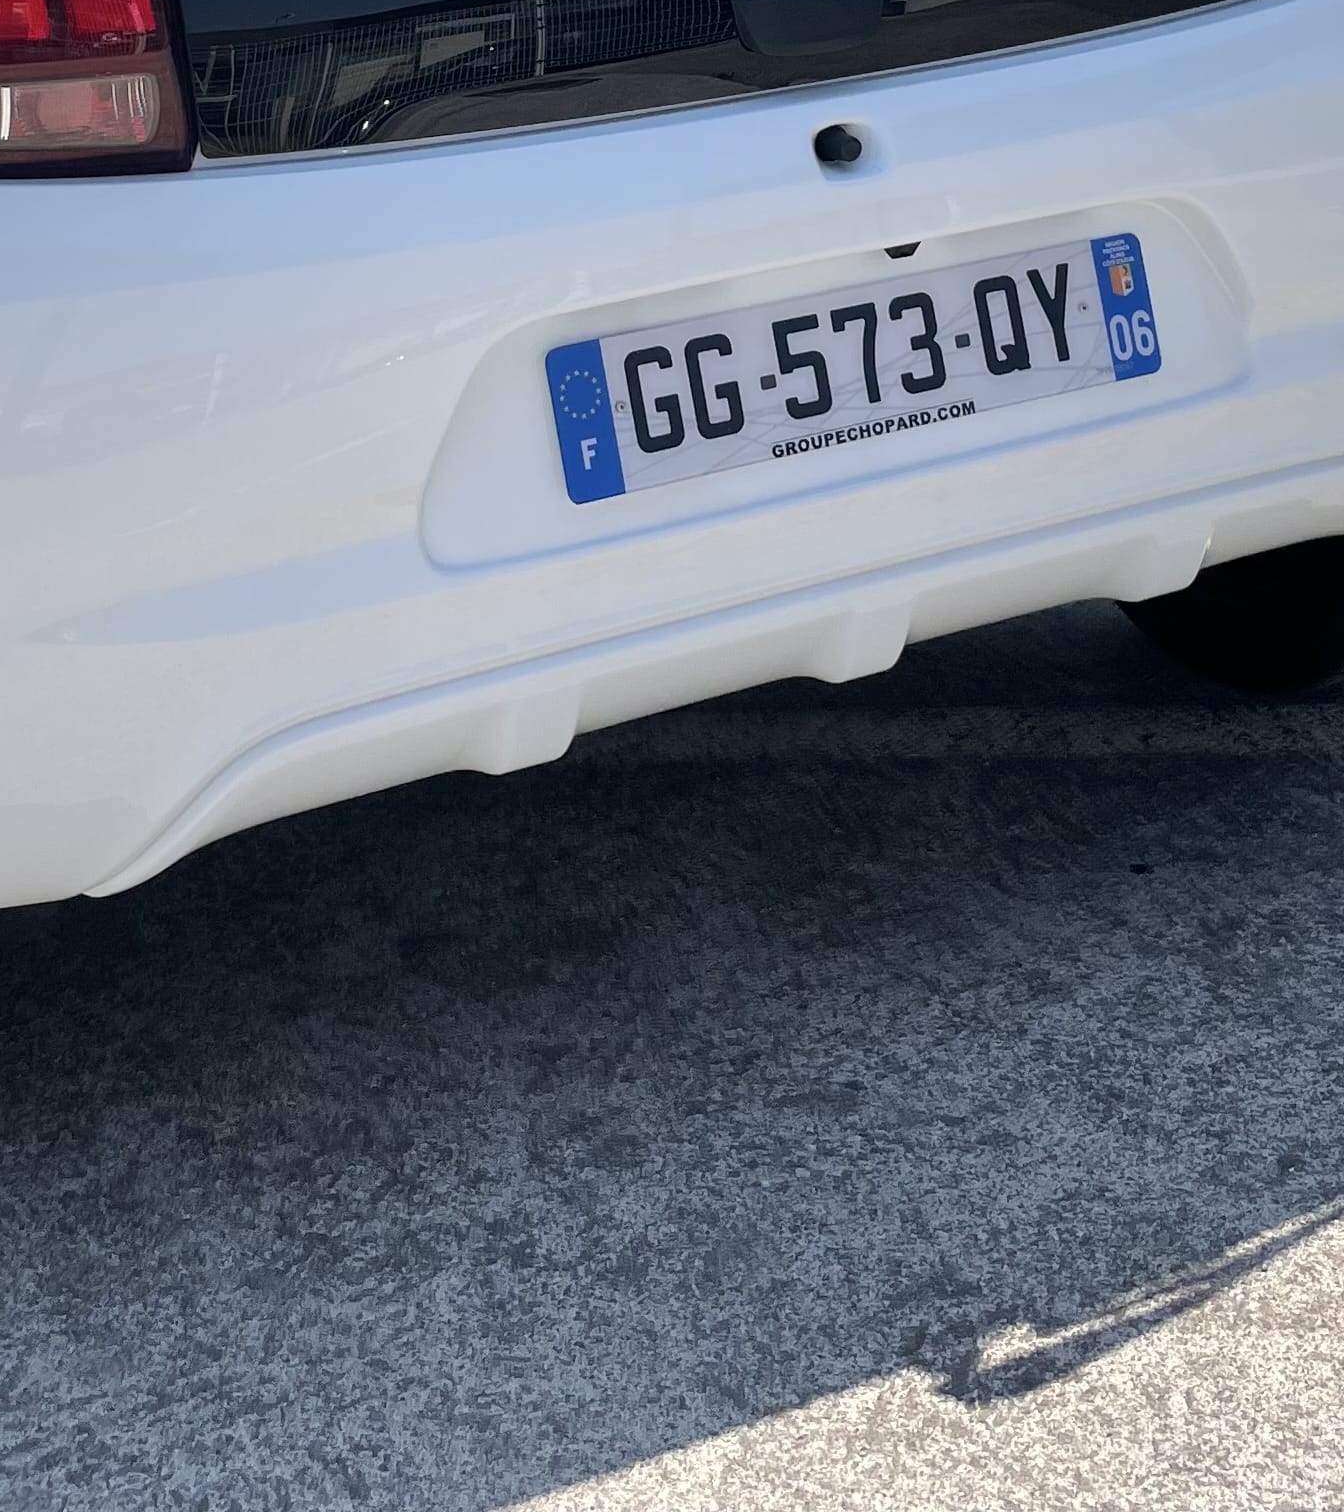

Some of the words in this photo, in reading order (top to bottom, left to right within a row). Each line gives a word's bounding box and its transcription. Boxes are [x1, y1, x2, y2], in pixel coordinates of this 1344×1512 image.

[1109, 309, 1155, 361] 06
[580, 437, 598, 470] F
[771, 400, 977, 459] GROUPECHOPARD.COM
